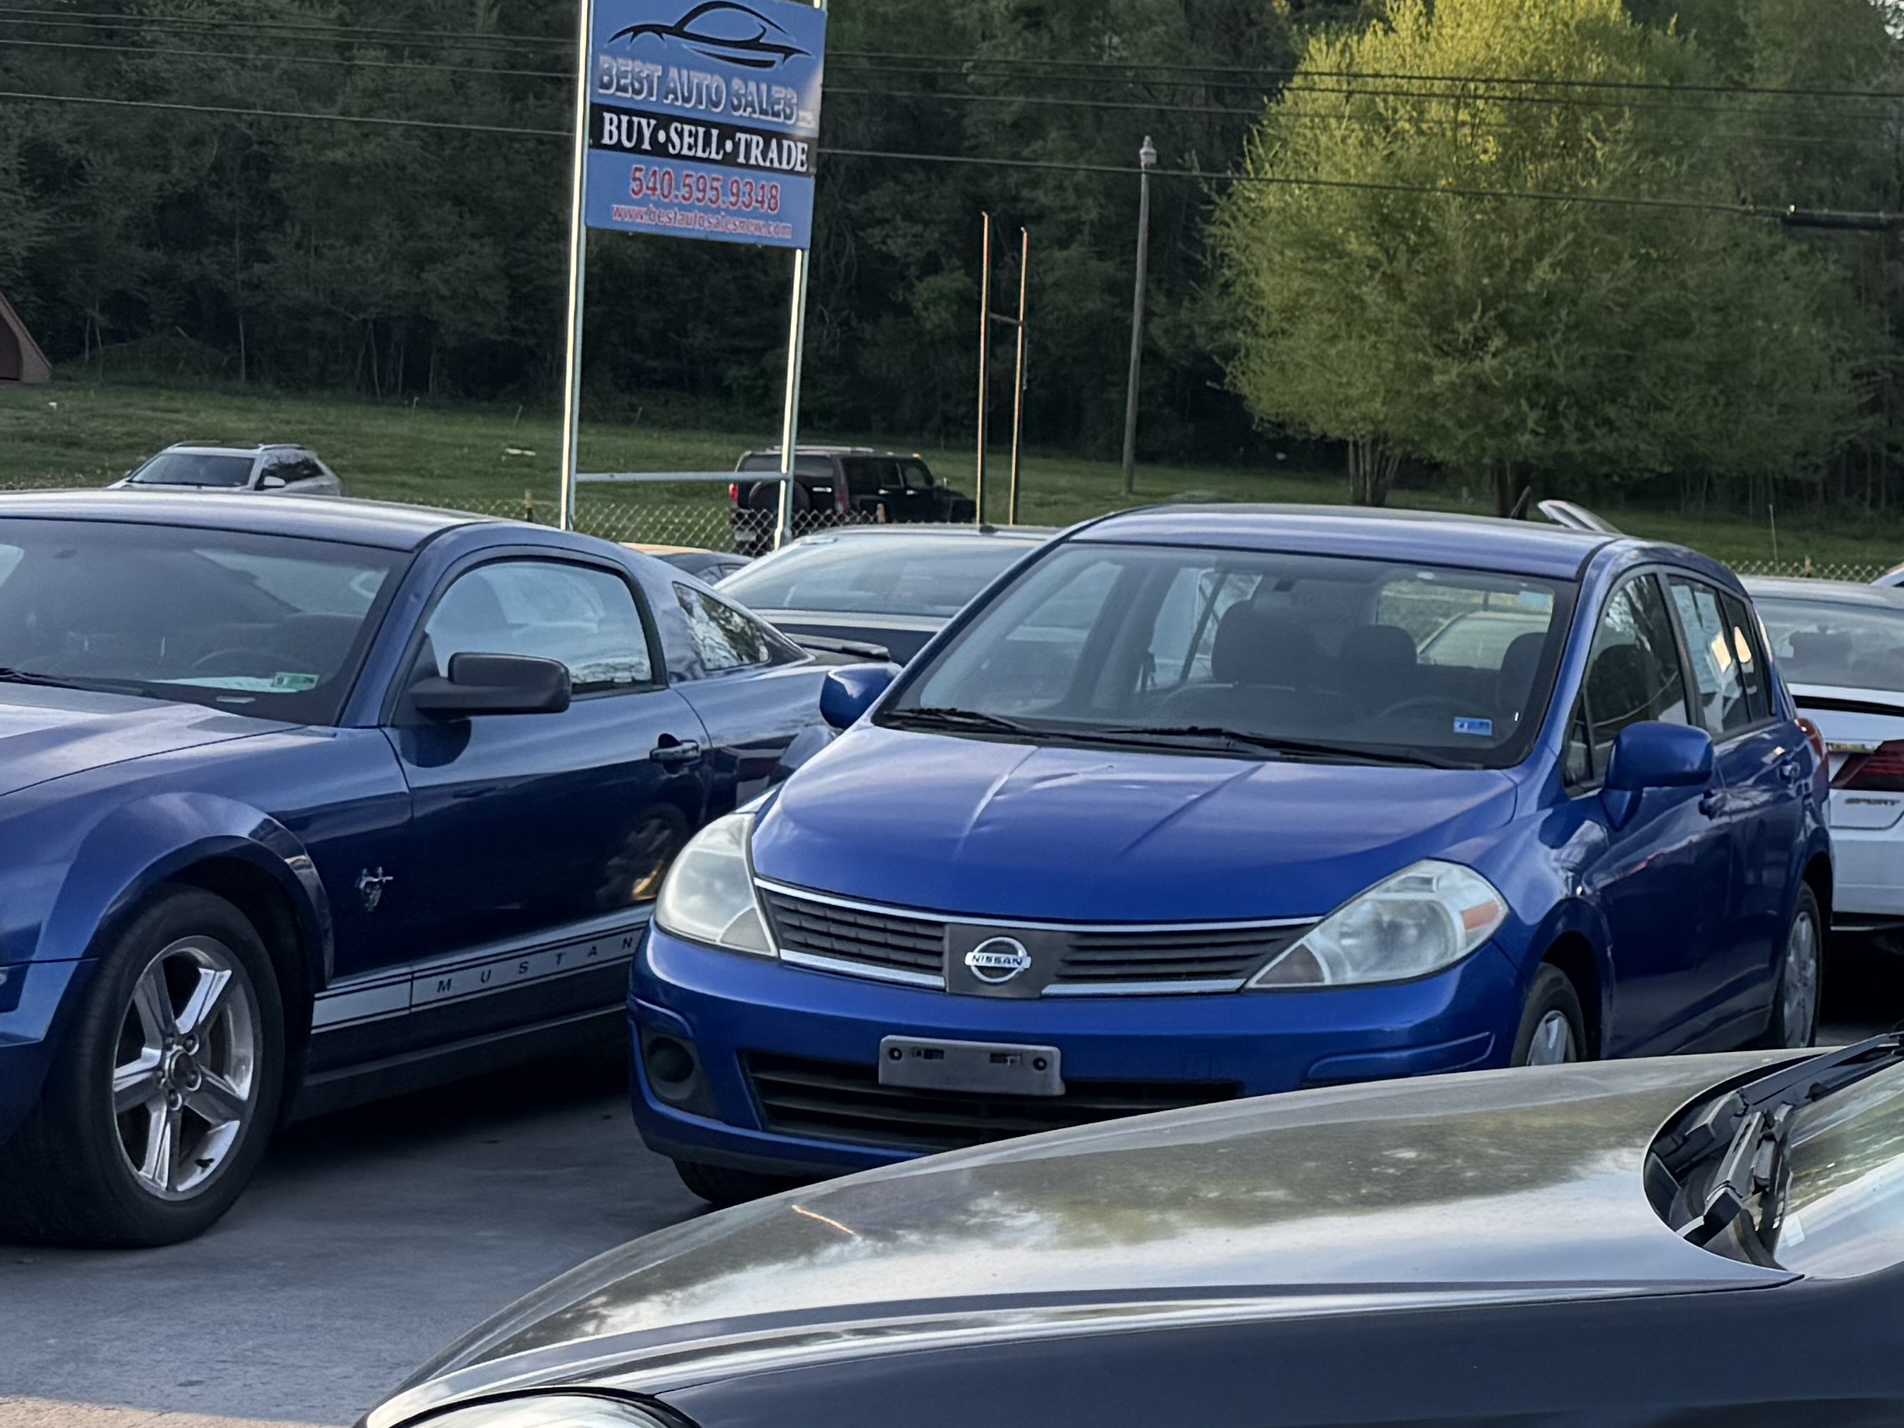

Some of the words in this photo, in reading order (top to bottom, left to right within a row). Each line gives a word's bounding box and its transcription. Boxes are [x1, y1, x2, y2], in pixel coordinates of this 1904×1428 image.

[598, 54, 662, 102] BEST
[664, 66, 727, 113] AUTO
[730, 77, 797, 124] SALES
[735, 132, 809, 172] TRADE
[630, 164, 781, 214] 540.595.9348
[436, 935, 635, 994] MUSTAN
[971, 954, 1023, 966] NISSAN
